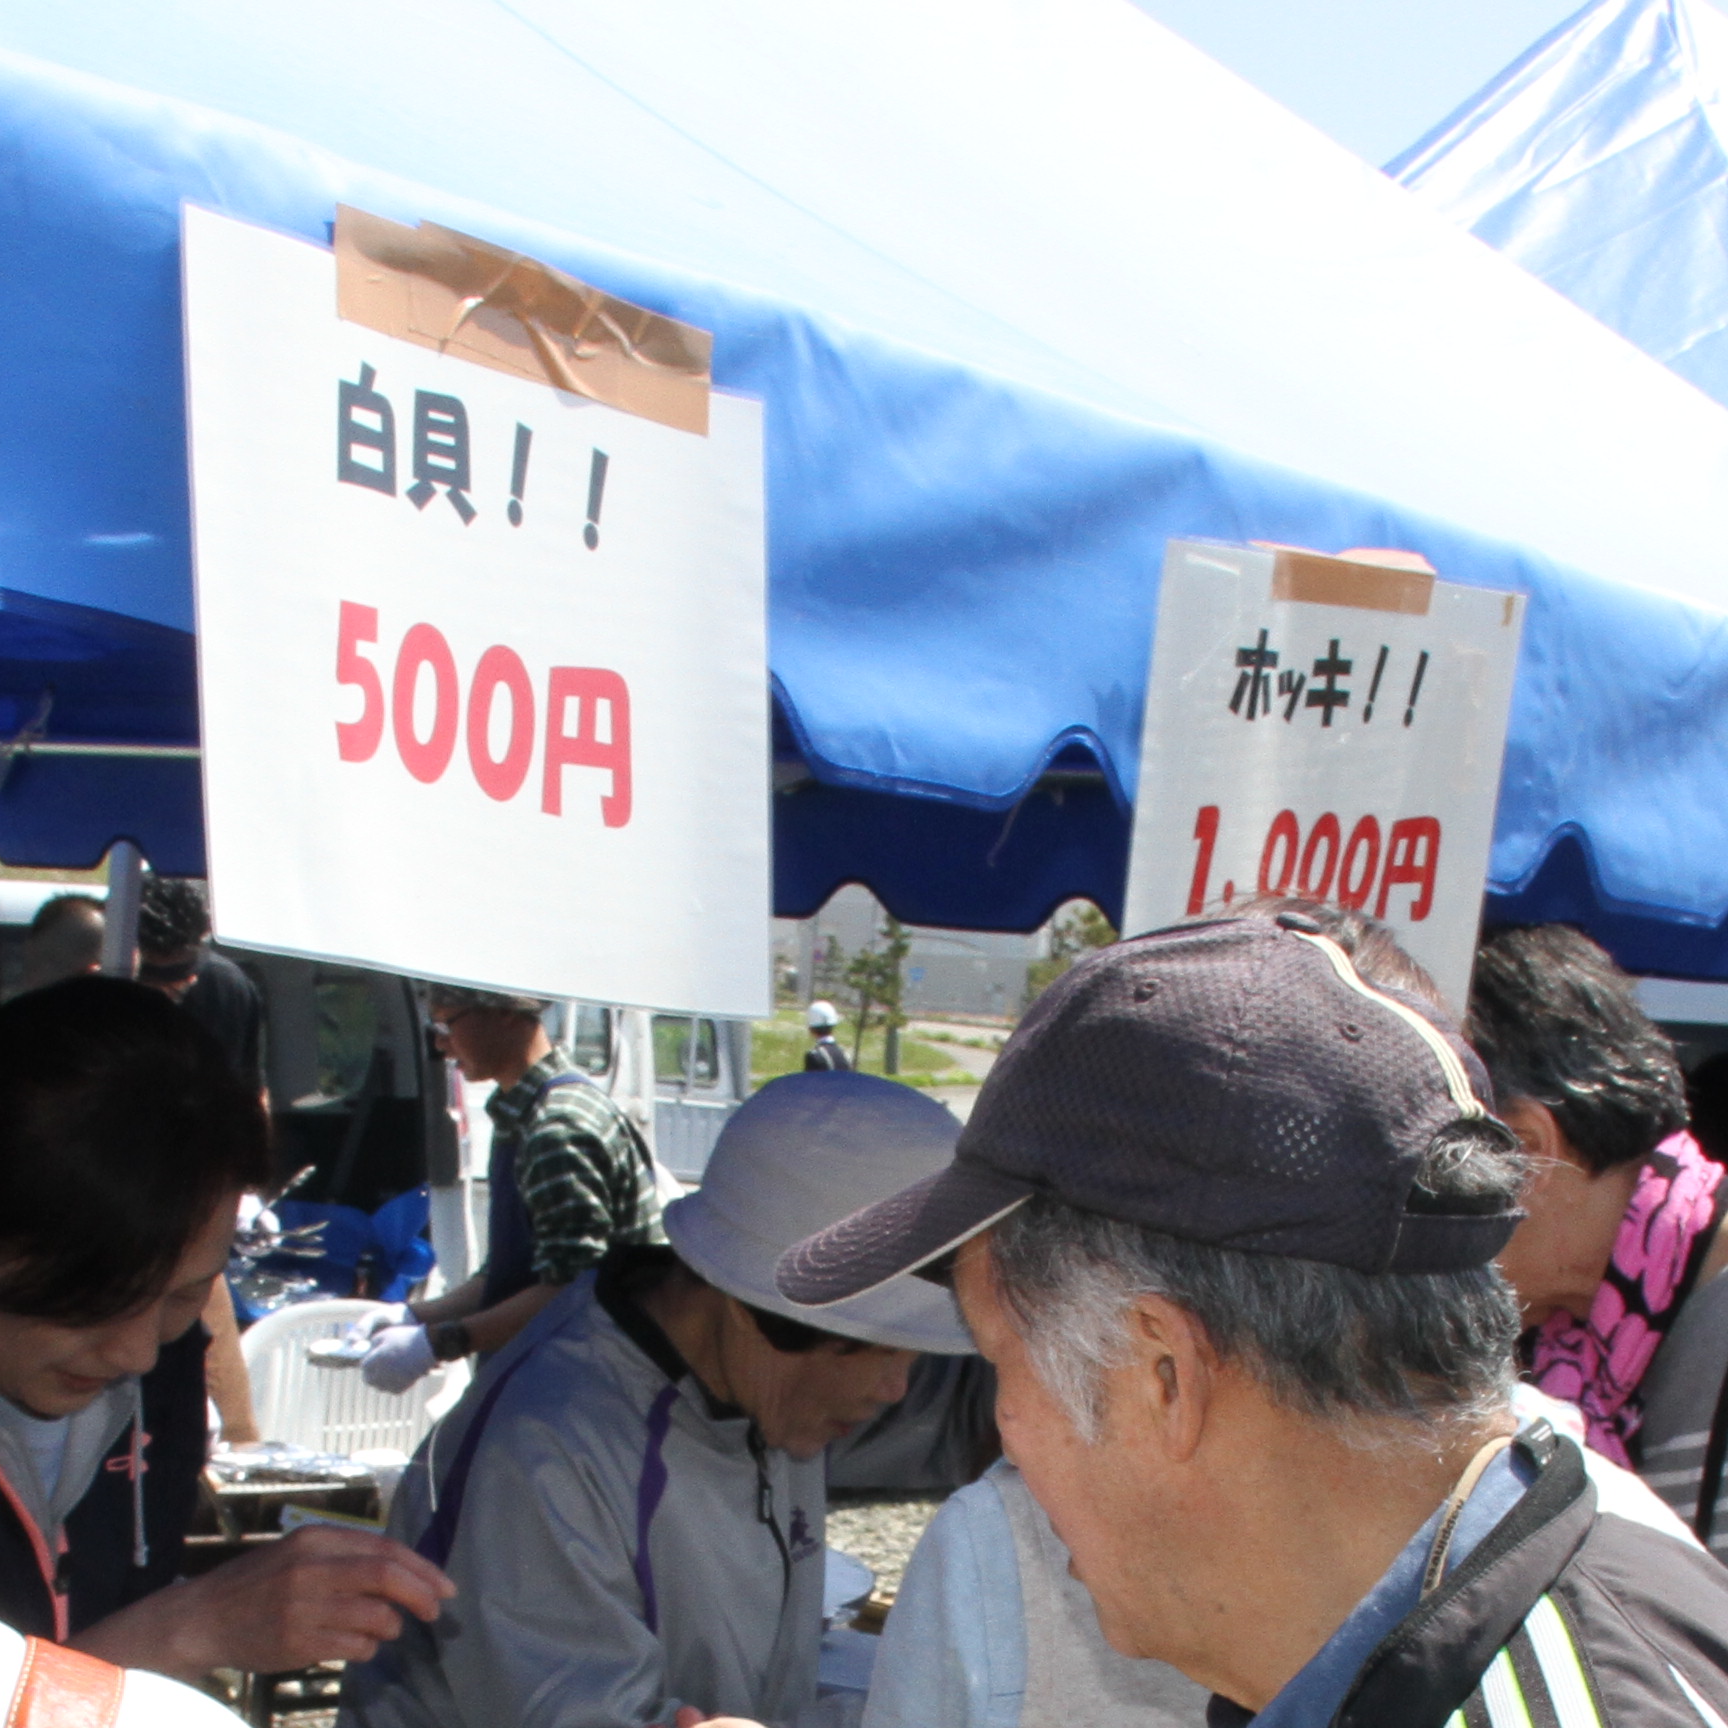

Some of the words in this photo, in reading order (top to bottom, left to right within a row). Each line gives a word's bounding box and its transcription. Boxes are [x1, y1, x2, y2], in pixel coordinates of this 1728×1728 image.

[336, 360, 610, 551] 白貝！！
[335, 599, 632, 829] 500円
[1228, 628, 1429, 728] ホッキ！！
